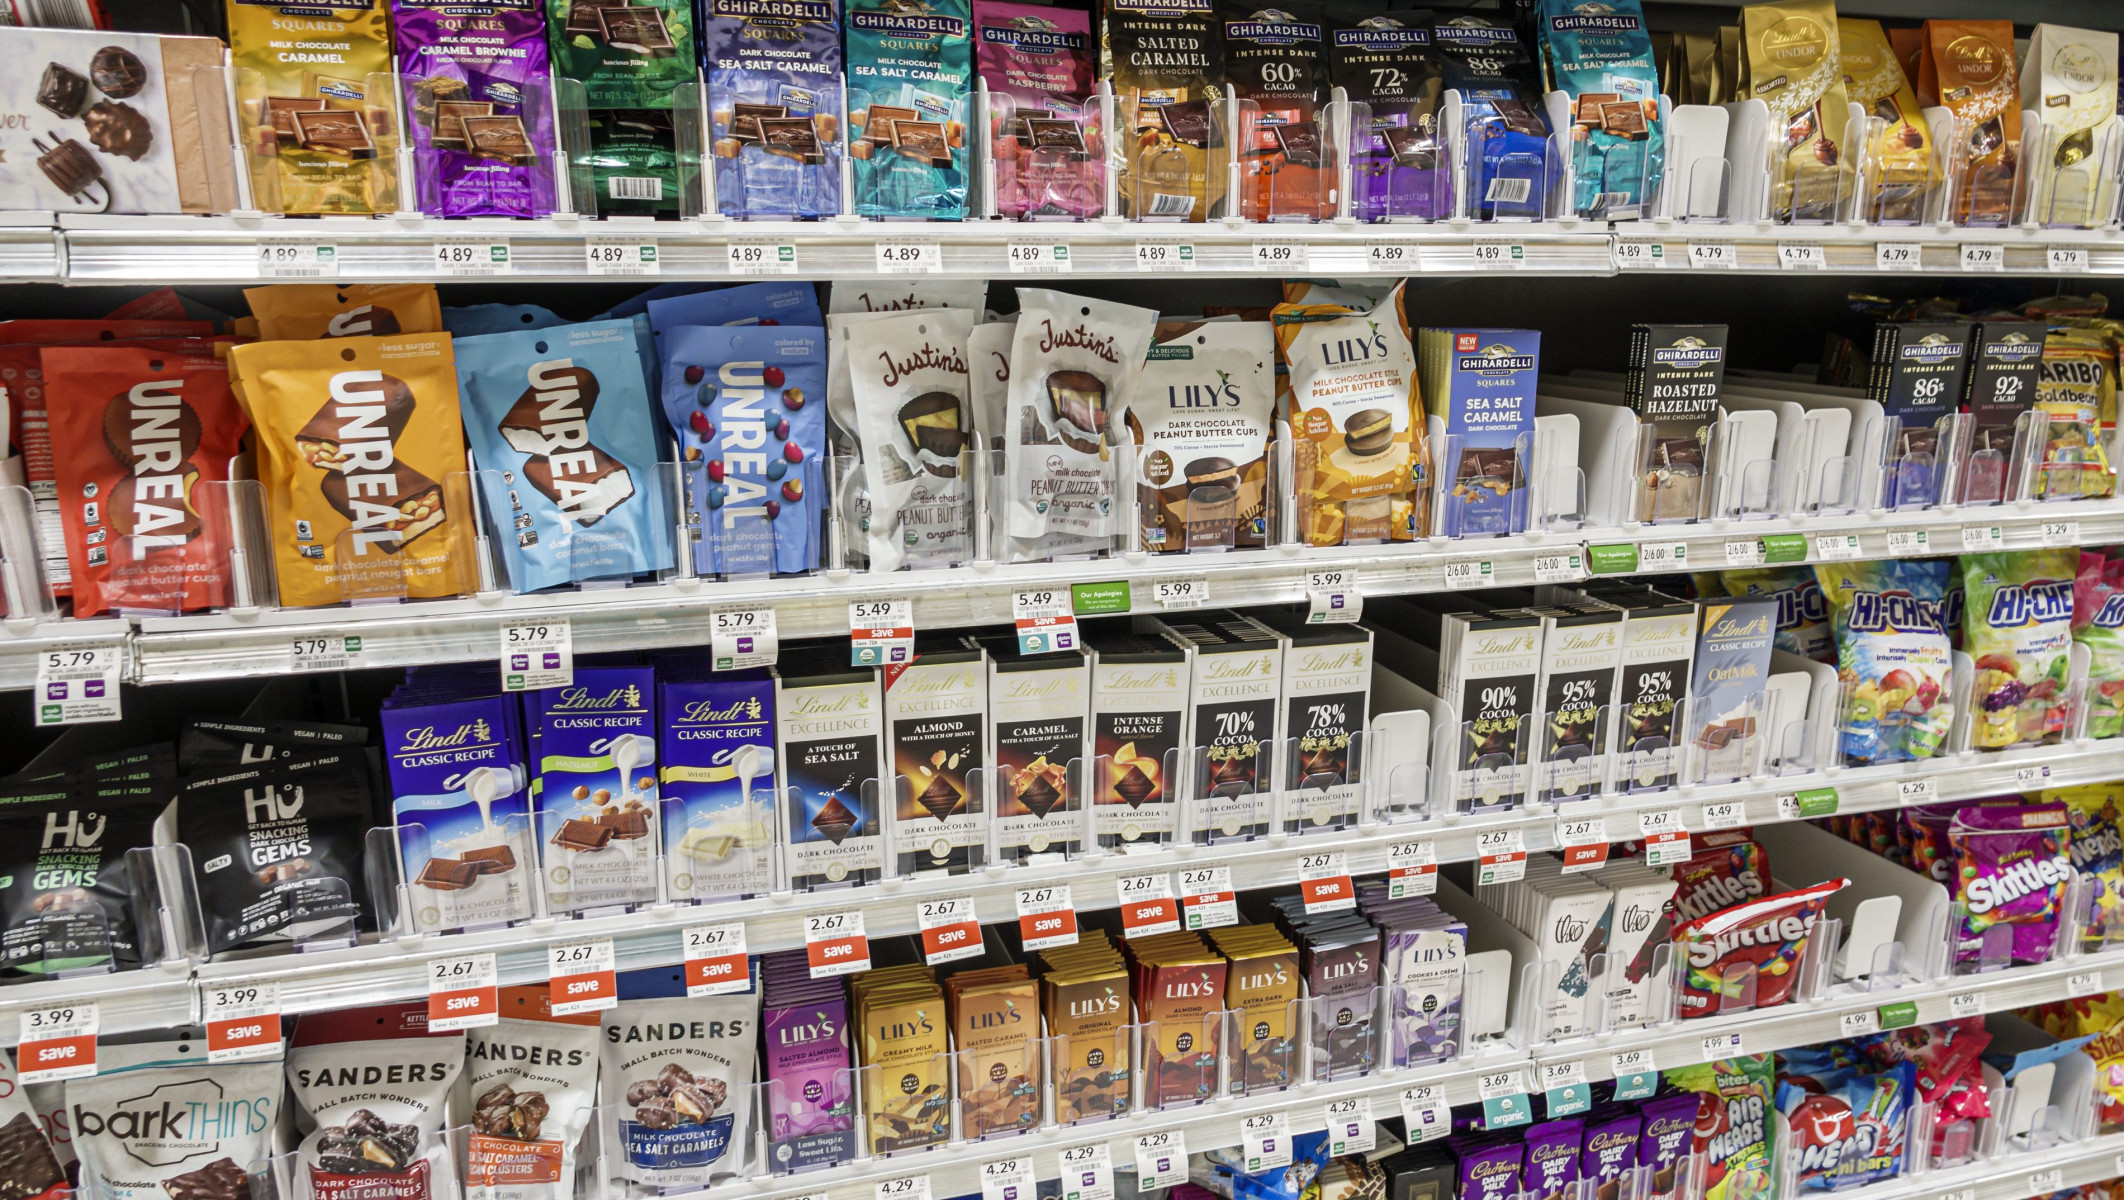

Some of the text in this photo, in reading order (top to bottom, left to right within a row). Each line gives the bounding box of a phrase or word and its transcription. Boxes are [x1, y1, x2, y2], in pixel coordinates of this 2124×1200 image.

[272, 19, 345, 33] SQUARES
[436, 18, 505, 31] SQUARES
[856, 15, 961, 36] GHIRARDELLI
[1124, 21, 1207, 32] INTENSE DARK
[1230, 24, 1318, 38] GHIRARDELLI
[1555, 17, 1637, 32] GHIRARDELLI
[440, 36, 504, 45] MILK CHOCOLATE
[986, 28, 1080, 48] GHIRARDELLI
[1339, 29, 1426, 44] GHIRARDELLI
[270, 41, 350, 51] MILK CHOCOLATE
[1138, 37, 1199, 51] SALTED
[278, 52, 345, 64] CARAMEL
[419, 46, 527, 58] CARAMEL BROWNIE
[763, 50, 811, 59] CHOCOLATE
[1777, 45, 1815, 59] LINDOR
[719, 59, 832, 74] SEA SALT CARAMEL
[1131, 52, 1210, 67] CARAMEL
[1467, 57, 1505, 71] 86%
[1563, 61, 1605, 71] SEA SALT
[856, 66, 962, 84] SEA SALT CARAMEL
[1006, 69, 1068, 82] DARK CHOCOLATE
[1261, 63, 1302, 82] 60%
[1370, 68, 1408, 87] 72%
[1008, 78, 1067, 92] RASPBERRY
[1372, 87, 1404, 96] CACAO
[1755, 76, 1787, 94] ASSORTED
[438, 247, 472, 262] 4.89
[590, 247, 623, 262] 4.89
[883, 247, 920, 261] 4.89
[1785, 248, 1810, 259] 4.79
[1967, 251, 1992, 262] 4.79
[774, 338, 815, 348] colored by
[1040, 319, 1119, 365] Justin's
[1460, 337, 1477, 345] NEW
[1321, 334, 1388, 366] LILY'S
[1657, 349, 1720, 363] GHIRARDELLI
[1904, 345, 1961, 357] GHIRARDELLI
[879, 342, 968, 387] Justin's
[1462, 357, 1531, 370] GHIRARDELLI
[1169, 385, 1241, 408] LILY'S
[1653, 384, 1716, 398] ROASTED
[1466, 397, 1523, 410] SEA SALT
[1647, 400, 1718, 412] HAZELNUT
[1168, 420, 1245, 428] DARK CHOCOLATE
[1464, 411, 1523, 423] CARAMEL
[1154, 428, 1258, 440] PEANUT BUTTER CUPS
[527, 358, 607, 535] UNREAL
[719, 361, 769, 529] UNREAL
[129, 379, 187, 561] UNREAL
[329, 370, 404, 556] UNREAL
[2045, 524, 2067, 535] 3.29
[1098, 590, 1122, 599] Apologies
[1160, 584, 1192, 597] 5.99
[1019, 592, 1052, 606] 5.49
[1988, 581, 2074, 626] HI-CHE
[856, 602, 891, 616] 5.49
[1034, 617, 1056, 627] save
[508, 627, 548, 641] 5.79
[871, 628, 894, 639] save
[294, 640, 326, 655] 5.79
[1711, 640, 1766, 651] CLASSIC RECIPE
[49, 653, 95, 667] 5.79
[1709, 667, 1757, 681] OatMilk
[1639, 671, 1671, 695] 95%
[1562, 680, 1596, 701] 95%
[553, 690, 625, 710] Lindt
[900, 697, 975, 713] EXCELLENCE
[1481, 686, 1517, 710] 90%
[679, 701, 740, 722] Lindt
[1308, 704, 1346, 728] 78%
[914, 721, 963, 734] ALMOND
[1114, 716, 1163, 725] INTENSE
[1214, 711, 1255, 736] 70%
[1013, 725, 1068, 737] CARAMEL
[1113, 725, 1163, 734] ORANGE
[1306, 727, 1345, 738] COCOA
[401, 725, 469, 751] Lindt
[1214, 736, 1255, 745] COCOA
[290, 756, 339, 770] VEGAN PALEO
[402, 749, 495, 769] CLASSIC RECIPE
[556, 760, 599, 771] HAZELNUT
[192, 771, 260, 788] SIMPLE INGREDIENTS
[687, 771, 712, 779] WHITE
[1902, 783, 1925, 794] 6.29
[1707, 806, 1731, 817] 4.49
[250, 824, 308, 841] SNACKING
[37, 854, 100, 866] SNACKING
[252, 841, 311, 866] GEMS
[207, 857, 230, 871] SALTY
[33, 870, 97, 889] GEMS
[1967, 857, 2069, 914] Skittles
[924, 902, 956, 916] 2.67
[811, 916, 844, 931] 2.67
[690, 931, 724, 946] 2.67
[938, 928, 966, 946] save
[556, 946, 592, 962] 2.67
[823, 943, 852, 958] save
[216, 989, 257, 1006] 3.99
[31, 1010, 74, 1027] 3.99
[1846, 1014, 1866, 1024] 4.99
[608, 1020, 743, 1044] SANDERS
[781, 1020, 834, 1044] LILY'S
[880, 1020, 933, 1042] LILY'S
[1078, 1021, 1112, 1031] ORIGINAL
[883, 1044, 933, 1058] CREAMY MILK
[621, 1048, 731, 1071] SMALL BATCH WONDERS
[298, 1063, 447, 1088] SANDERS
[1484, 1075, 1508, 1088] 3.69
[1716, 1072, 1749, 1087] bites
[341, 1093, 429, 1113] BATCH WONDERS
[1493, 1110, 1525, 1126] organic
[485, 1143, 541, 1153] CHOCOLATE
[646, 1137, 724, 1155] SALT CARAMELS
[1531, 1143, 1581, 1164] Cadbury
[986, 1161, 1017, 1175] 4.29
[1543, 1154, 1572, 1169] DAIRY
[1471, 1160, 1522, 1181] Cadbury
[1543, 1164, 1565, 1176] MILK
[1482, 1172, 1512, 1185] DAIRY
[882, 1181, 913, 1194] 4.29
